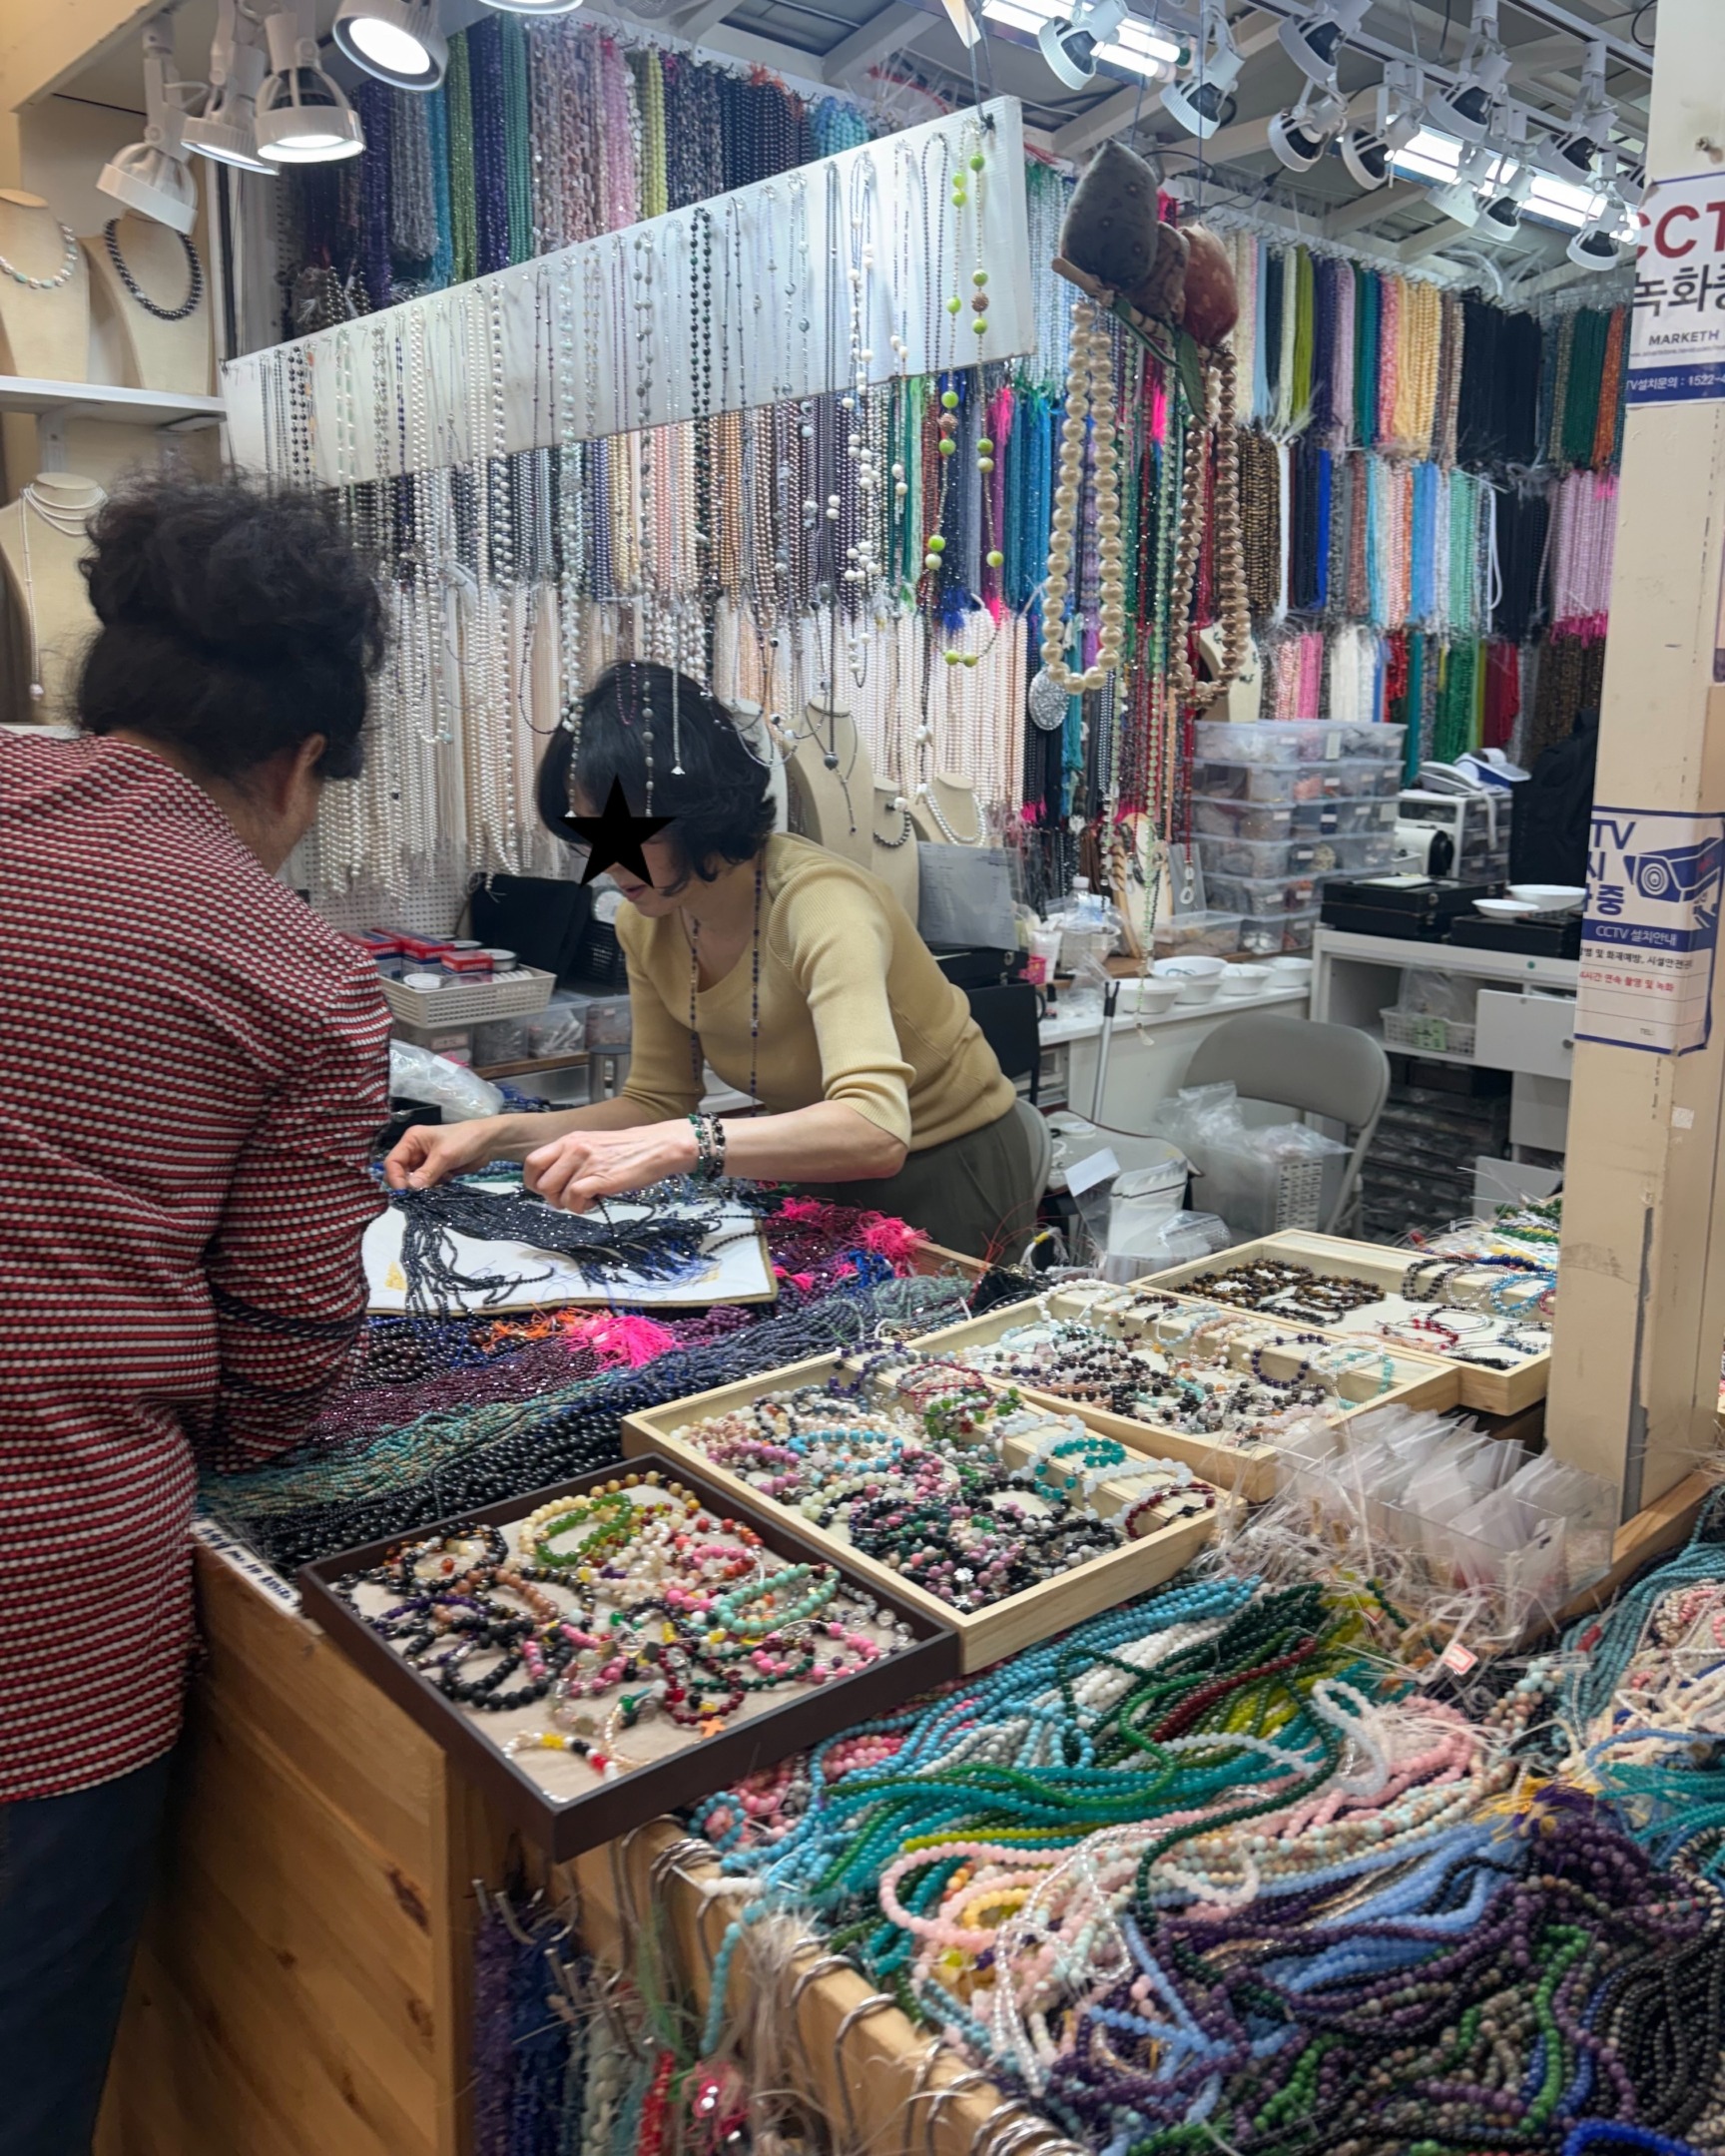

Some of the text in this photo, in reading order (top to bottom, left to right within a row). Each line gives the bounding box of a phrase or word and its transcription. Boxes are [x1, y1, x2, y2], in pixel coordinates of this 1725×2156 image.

[1633, 264, 1725, 317] 녹화
[1648, 329, 1720, 346] MARKETH
[1595, 925, 1677, 947] CCTV 설치안내
